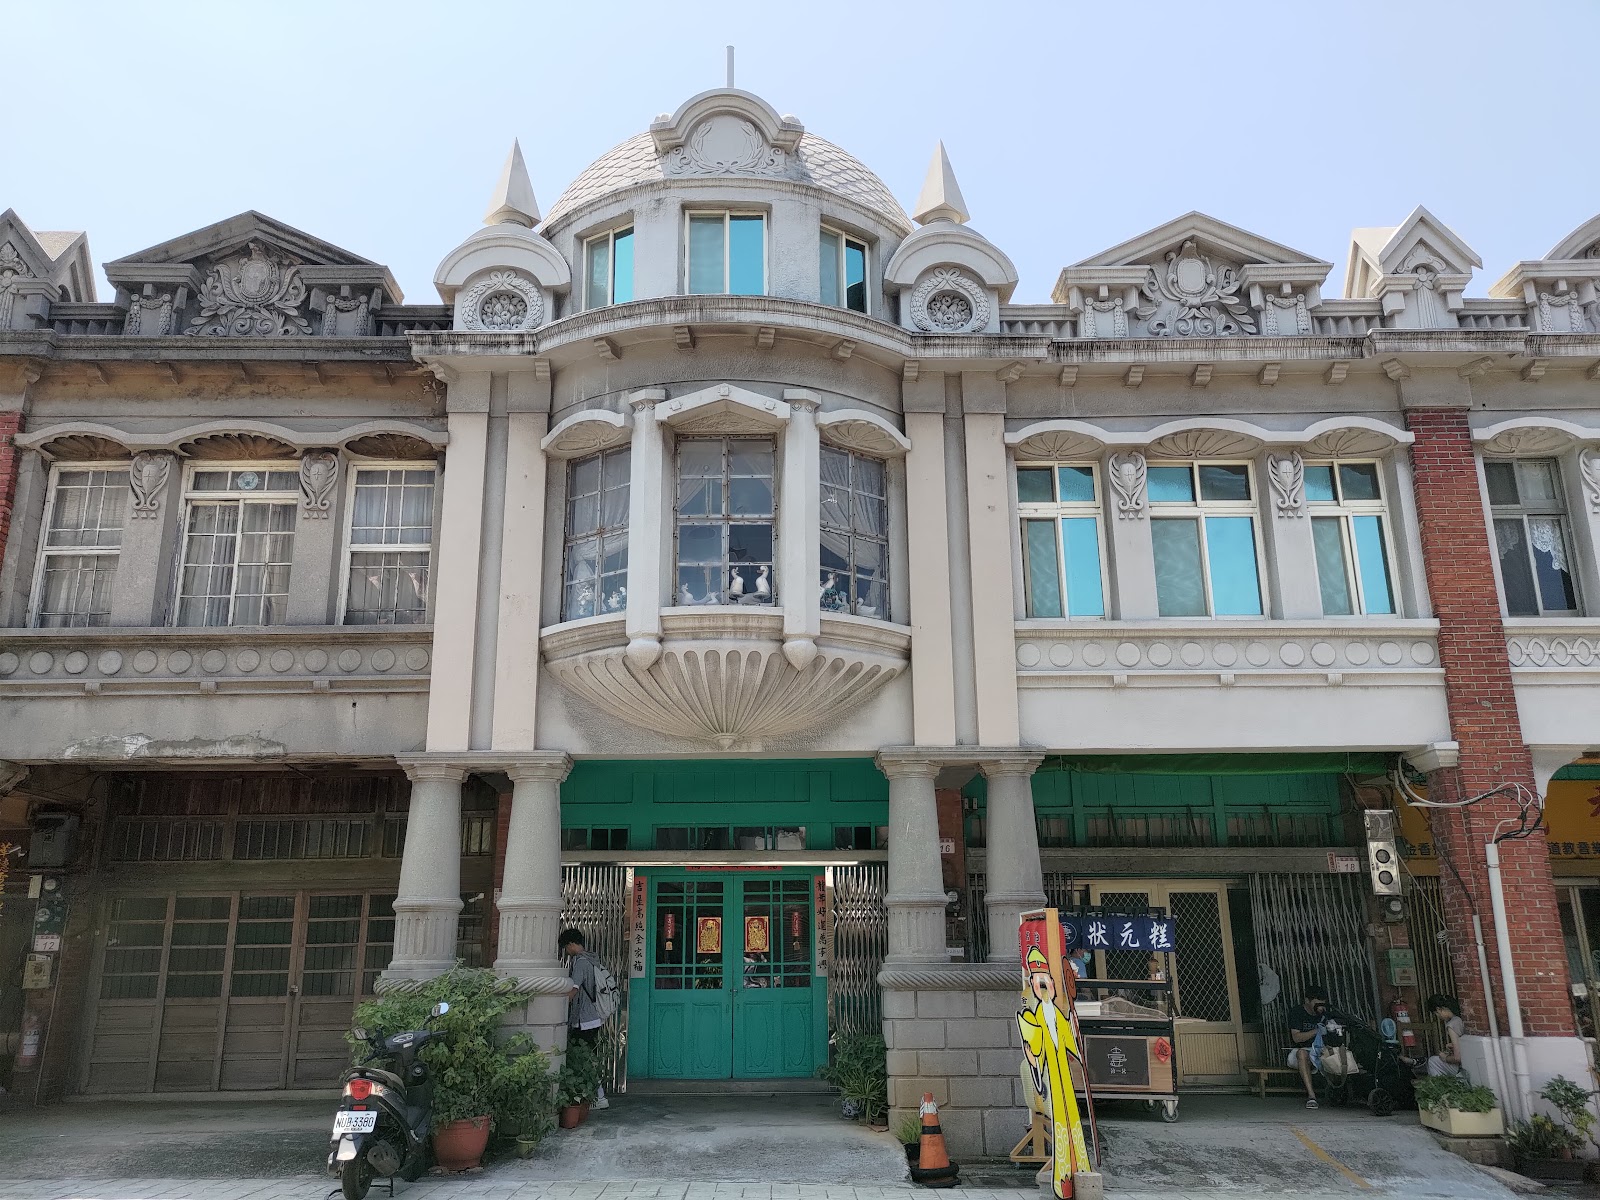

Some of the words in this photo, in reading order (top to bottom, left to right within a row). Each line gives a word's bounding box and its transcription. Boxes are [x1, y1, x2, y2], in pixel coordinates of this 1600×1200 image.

[1345, 863, 1356, 872] 18
[633, 880, 645, 972] 吉星高照全家福
[1087, 920, 1172, 950] 狀元糕
[42, 941, 56, 951] 12
